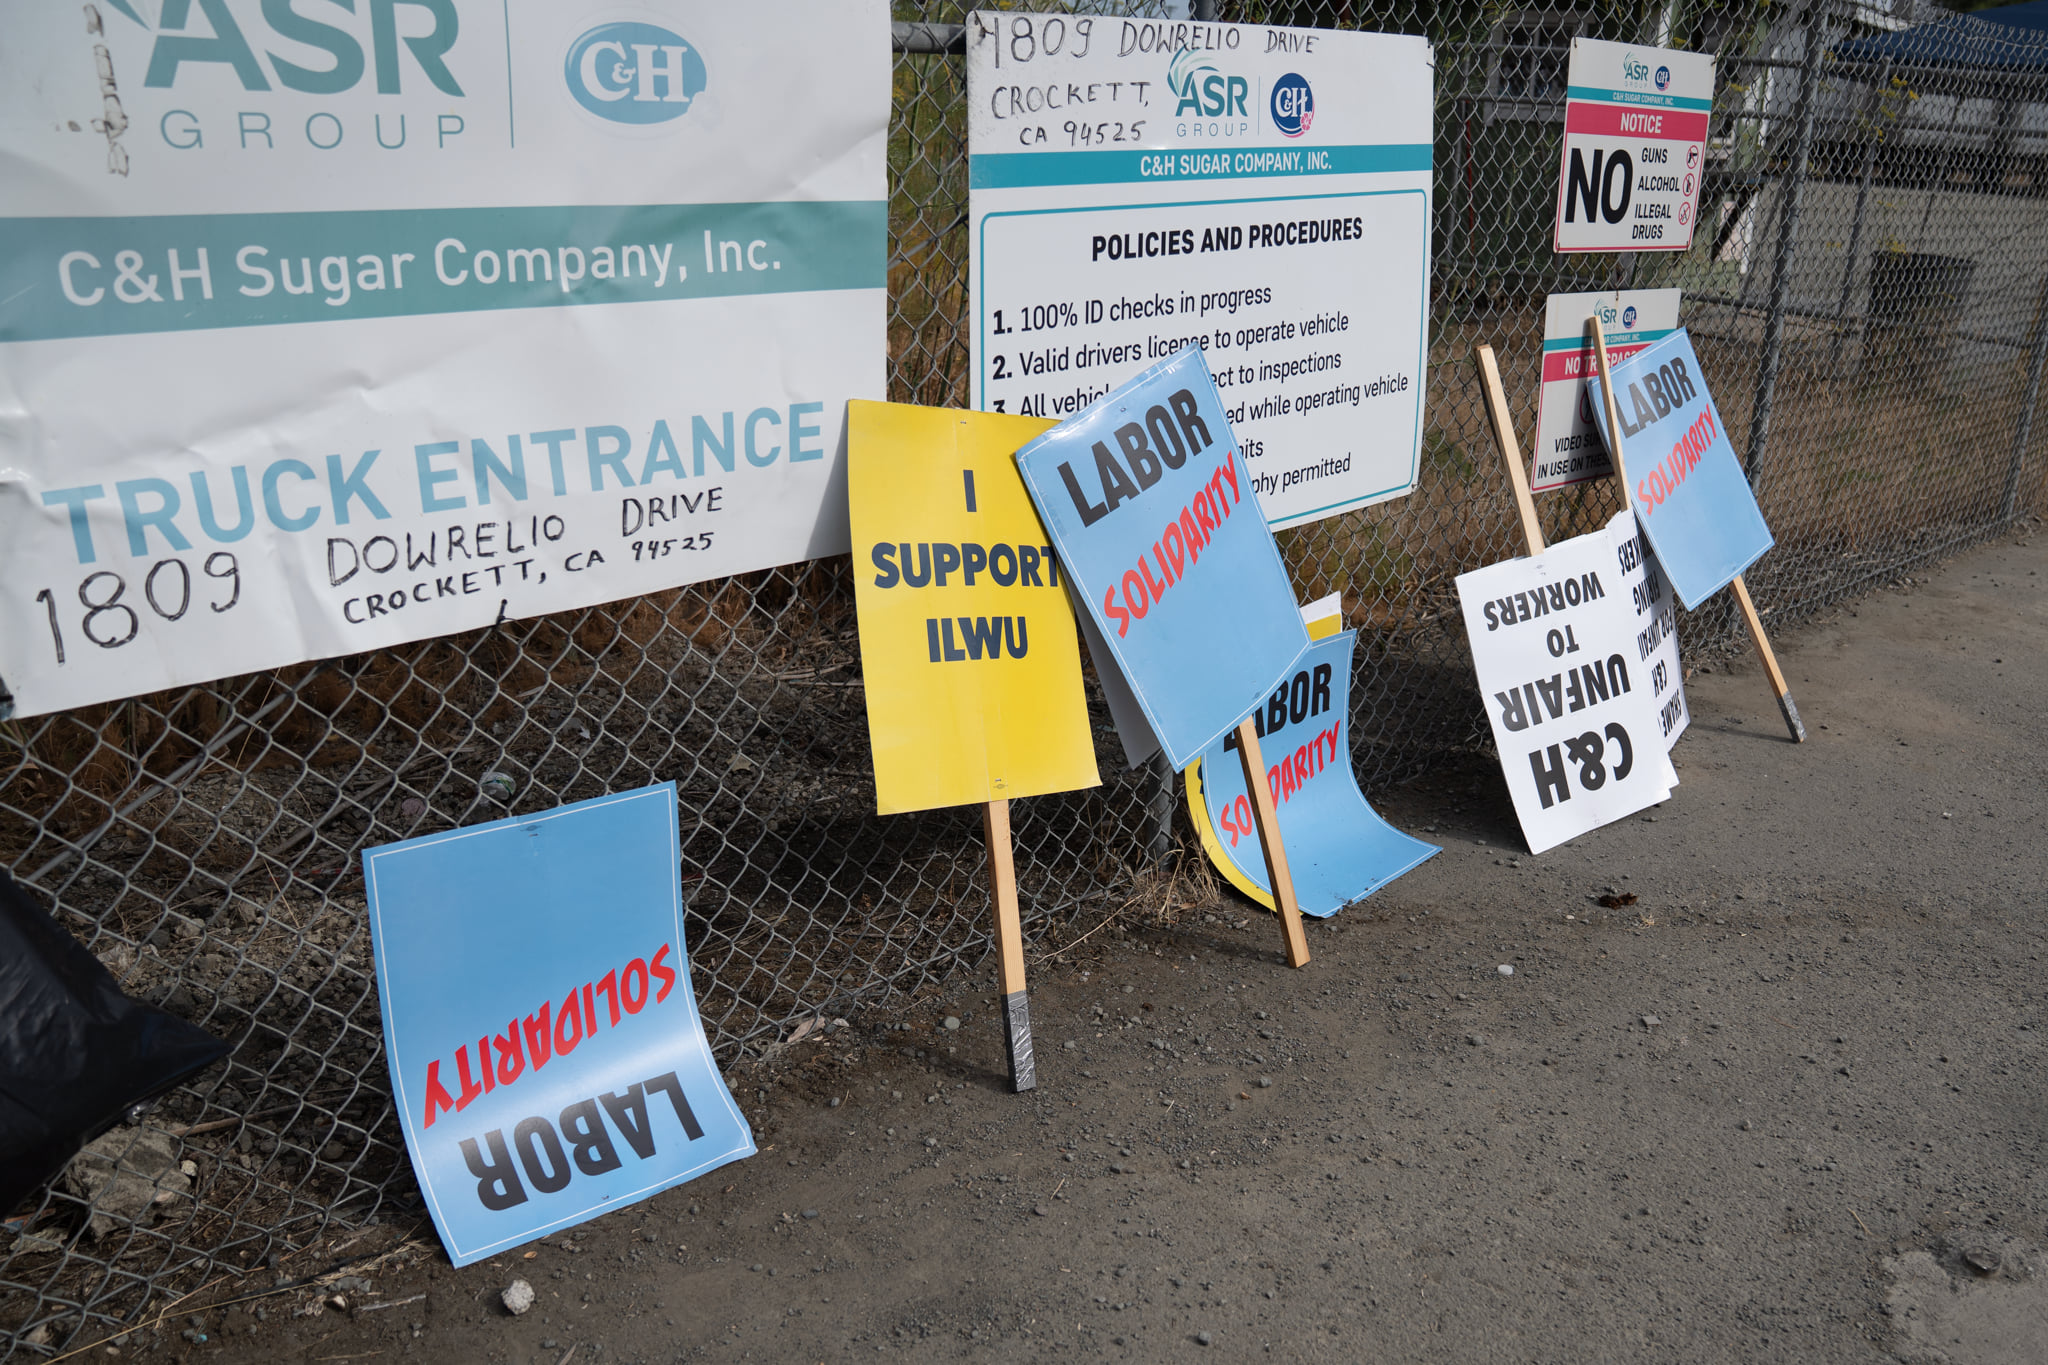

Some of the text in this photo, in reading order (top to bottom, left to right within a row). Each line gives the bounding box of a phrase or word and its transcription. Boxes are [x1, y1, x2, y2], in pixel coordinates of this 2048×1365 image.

[144, 0, 466, 97] ASR
[981, 17, 1319, 69] 1809 DOWRELIO DRIVE
[580, 40, 690, 103] C&H
[1175, 70, 1248, 118] ASR
[1624, 62, 1649, 81] ASR
[992, 81, 1152, 120] CROCKETT,
[1275, 87, 1310, 118] C&H
[1624, 93, 1641, 102] SUGAR
[161, 109, 466, 150] GROUP
[1019, 120, 1147, 147] CA 94525
[1176, 122, 1249, 138] GROUP
[1620, 112, 1663, 134] NOTICE
[1140, 151, 1333, 177] C&H SUGAR COMPANY, INC.
[1641, 147, 1669, 164] GUNS
[1564, 148, 1633, 224] NO
[1637, 175, 1681, 192] ALCOHOL
[1631, 224, 1664, 240] DRUGS
[1634, 203, 1672, 219] ILLEGAL
[1092, 217, 1363, 262] POLICIES AND PROCEDURES
[58, 230, 782, 307] C&H Sugar Company, Inc.
[992, 287, 1272, 335] 1. 100% ID checks in progress
[992, 354, 1013, 380] 2.
[1019, 346, 1069, 376] Valid
[1075, 342, 1142, 369] drivers
[1215, 328, 1231, 349] to
[1235, 320, 1296, 351] operate
[1299, 311, 1350, 338] vehicle
[1564, 356, 1581, 376] NO
[1020, 393, 1047, 417] All
[1238, 365, 1255, 385] to
[1258, 351, 1342, 383] inspections
[1249, 395, 1291, 421] while
[1294, 384, 1361, 416] operating
[1364, 372, 1409, 399] vehicle
[1613, 356, 1697, 439] LABOR
[1057, 387, 1214, 529] LABOR
[1555, 435, 1582, 453] VIDEO
[1638, 402, 1717, 517] SOLIDARITY
[42, 402, 825, 565] TRUCK ENTRANCE
[963, 469, 977, 513] I
[1282, 451, 1352, 493] permitted
[1538, 463, 1548, 480] IN
[1550, 460, 1568, 476] USE
[1570, 457, 1583, 472] ON
[871, 542, 1058, 589] SUPPORT
[1103, 451, 1243, 639] SOLIDARITY
[37, 488, 723, 665] 1809 DOWRELIO DRIVE
[343, 532, 714, 624] CROCKETT, CA 94525
[1632, 570, 1661, 616] FIRING
[1483, 571, 1605, 631] WORKERS
[1659, 604, 1673, 639] FOR
[926, 616, 1028, 663] ILWU
[1546, 624, 1580, 658] TO
[1494, 653, 1631, 732] UNFAIR
[1651, 659, 1667, 698] C&H
[1660, 688, 1682, 738] SHAME
[1220, 718, 1341, 848] SODARITY
[1528, 722, 1633, 810] C&H
[423, 942, 677, 1130] SOLIDARITY
[458, 1071, 705, 1211] LABOR
